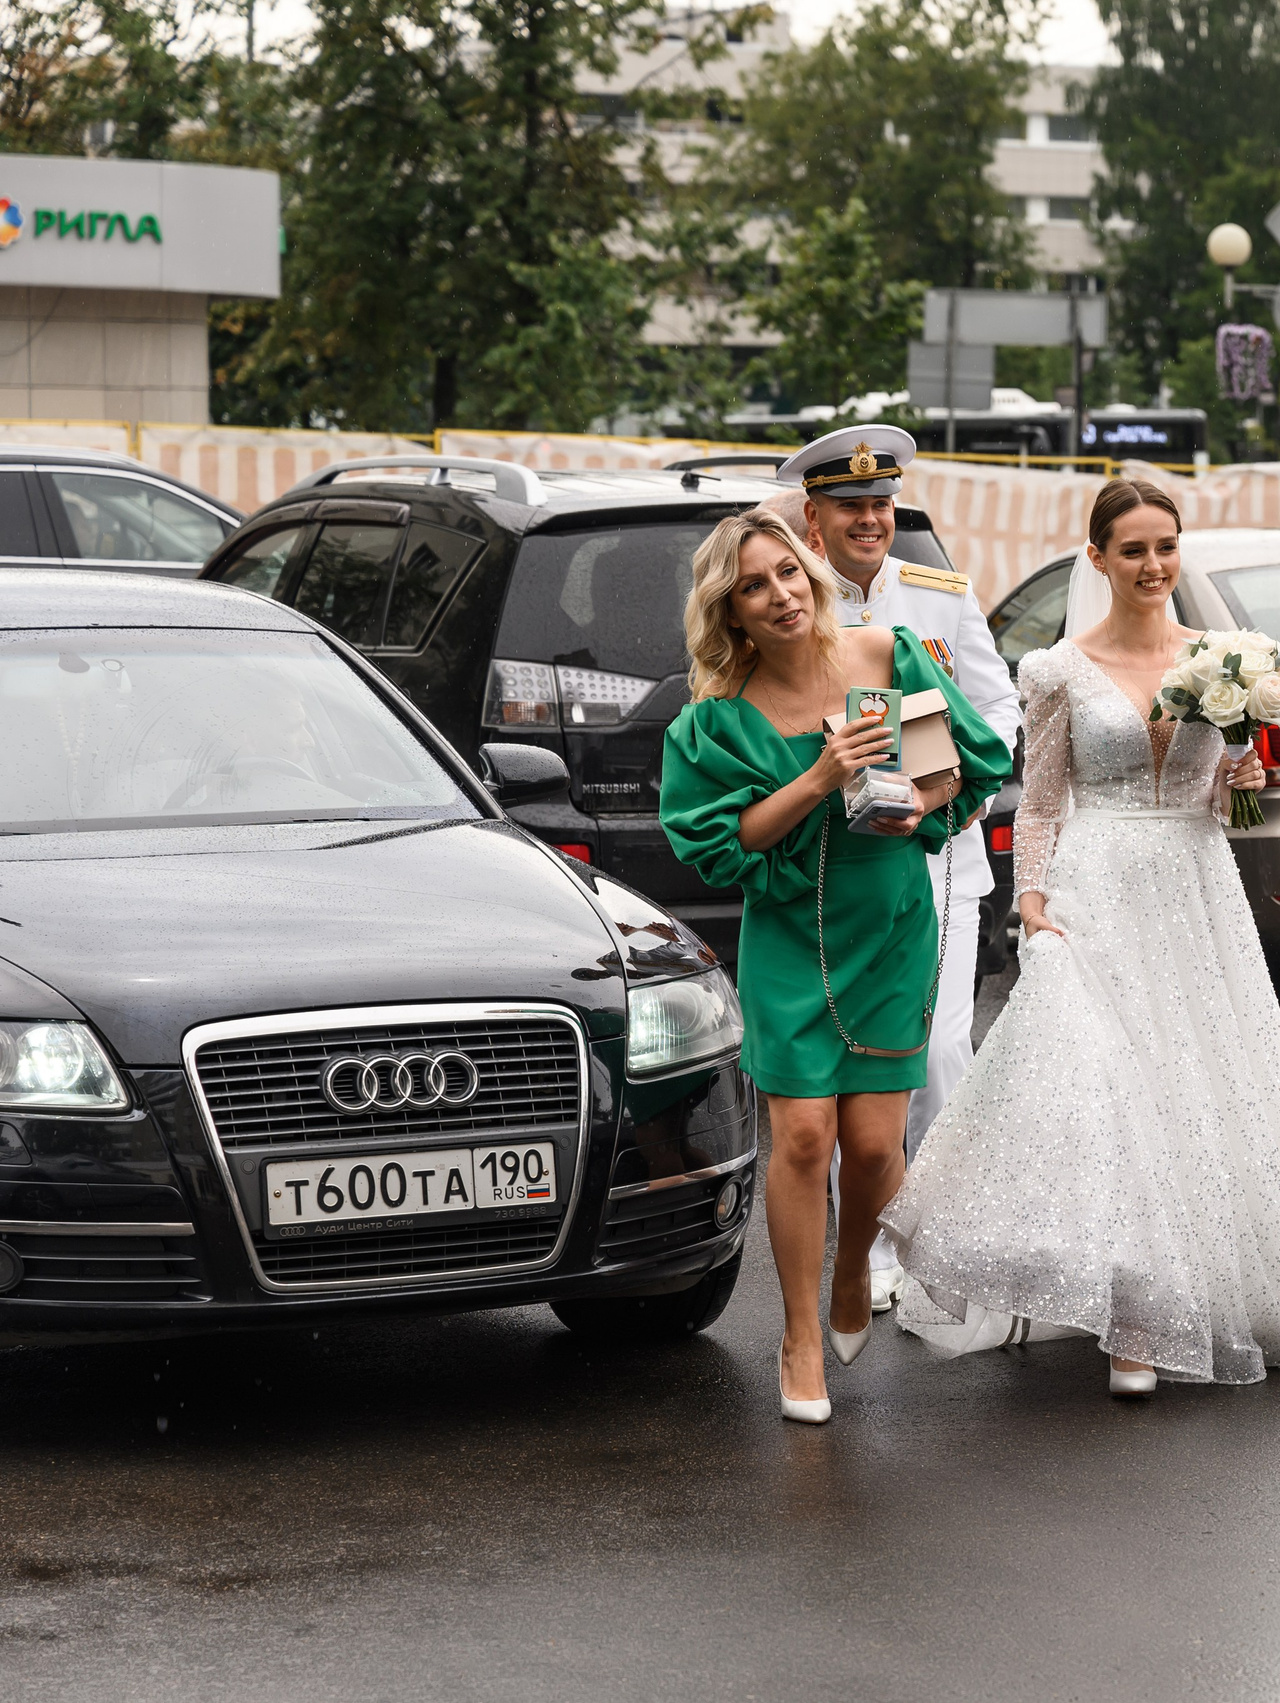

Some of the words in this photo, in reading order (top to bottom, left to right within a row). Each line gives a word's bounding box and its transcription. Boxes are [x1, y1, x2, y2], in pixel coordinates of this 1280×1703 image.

[34, 208, 162, 244] РИГЛА
[582, 783, 641, 794] MITSUBISHI
[479, 1149, 543, 1187] 190
[493, 1186, 526, 1201] RUS
[494, 1208, 515, 1219] 730
[314, 1224, 344, 1235] Ауди
[348, 1221, 383, 1232] Центр
[386, 1219, 414, 1228] Сити
